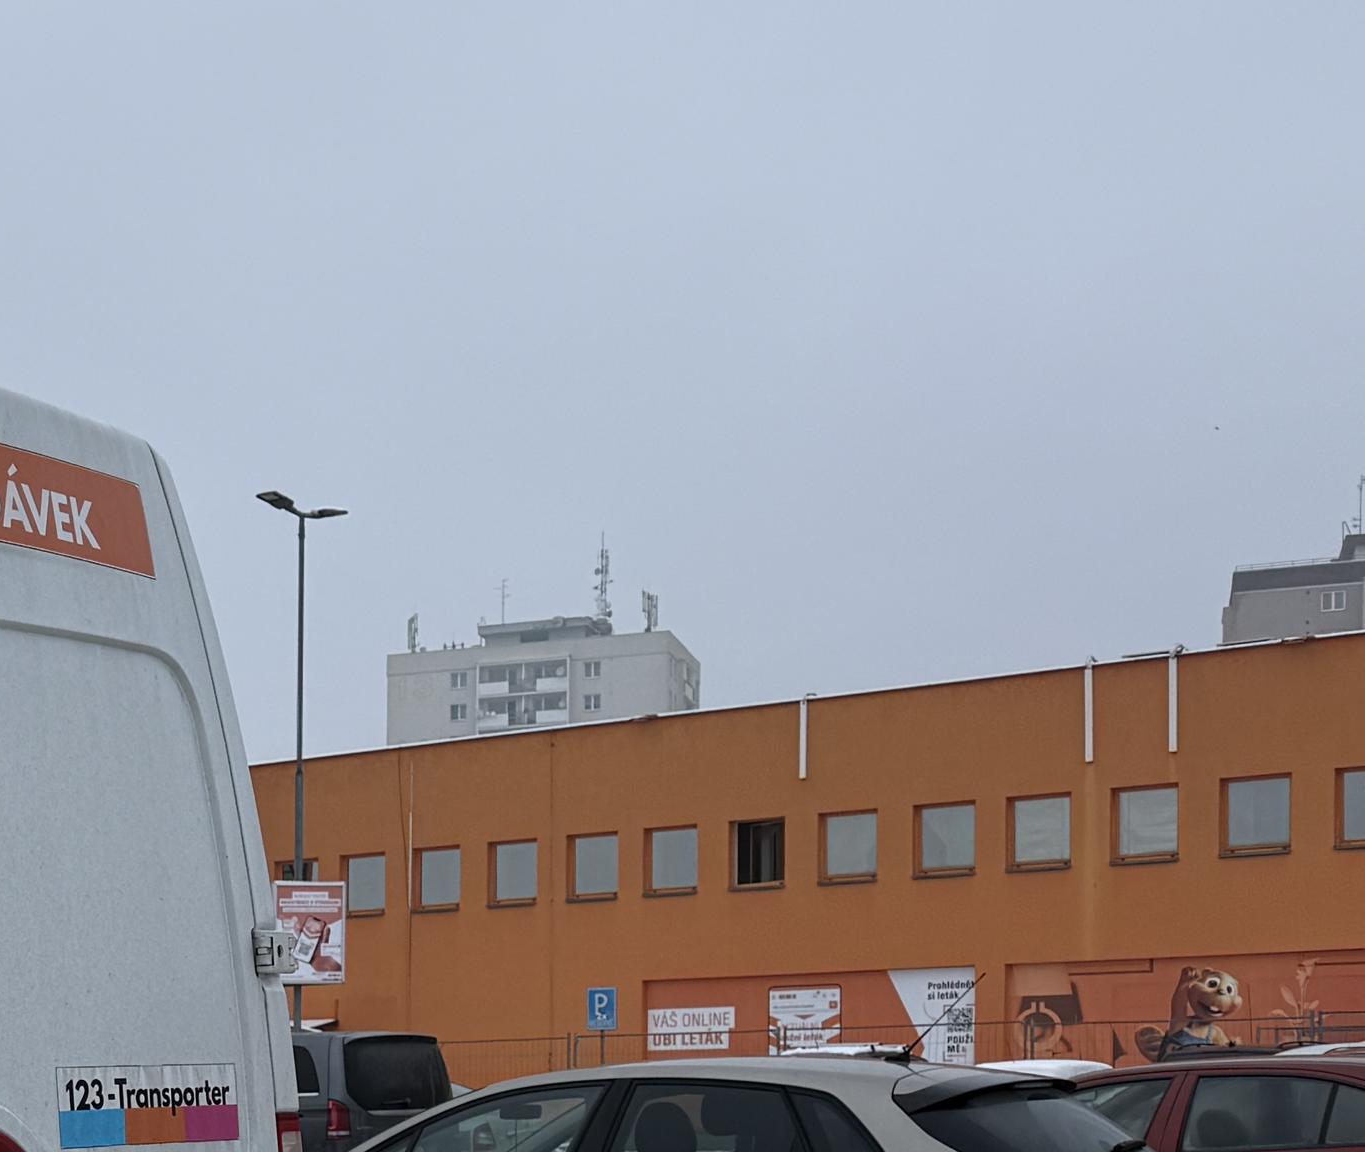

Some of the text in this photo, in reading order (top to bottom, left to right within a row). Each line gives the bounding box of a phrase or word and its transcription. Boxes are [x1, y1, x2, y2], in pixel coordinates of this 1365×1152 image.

[652, 1010, 730, 1028] VÁŠ ONLINE
[681, 1029, 723, 1046] LETÁK
[65, 1077, 230, 1117] 123-Transporter
